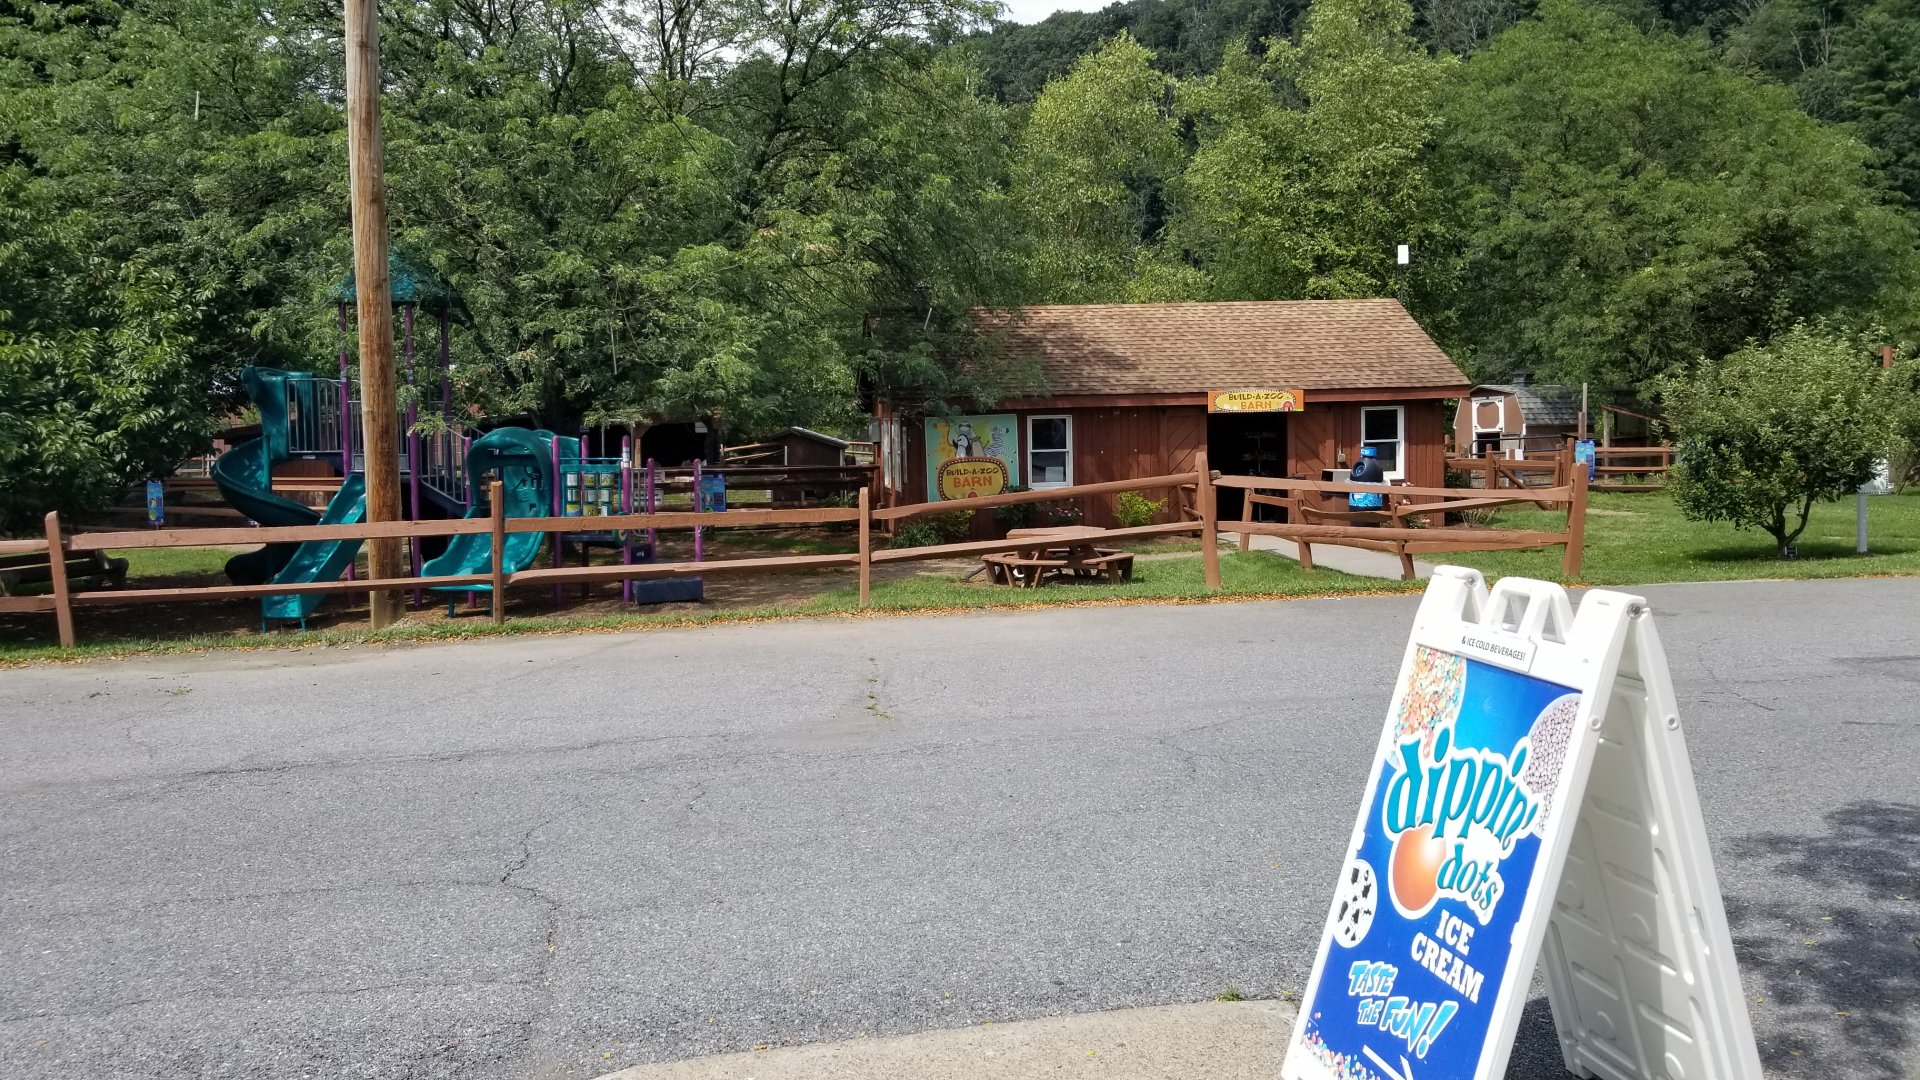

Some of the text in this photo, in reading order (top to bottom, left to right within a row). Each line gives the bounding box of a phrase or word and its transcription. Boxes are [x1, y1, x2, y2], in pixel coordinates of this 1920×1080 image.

[1241, 401, 1272, 410] BARN
[953, 475, 992, 488] BARN
[1462, 636, 1526, 660] & ICE COLD BEVERAGES!
[1386, 727, 1538, 851] dippin'
[1436, 843, 1498, 911] dots
[1435, 908, 1475, 956] ICE
[1348, 960, 1399, 997] TASTE
[1411, 931, 1485, 1004] CREAM
[1357, 996, 1459, 1060] THE FUN!
